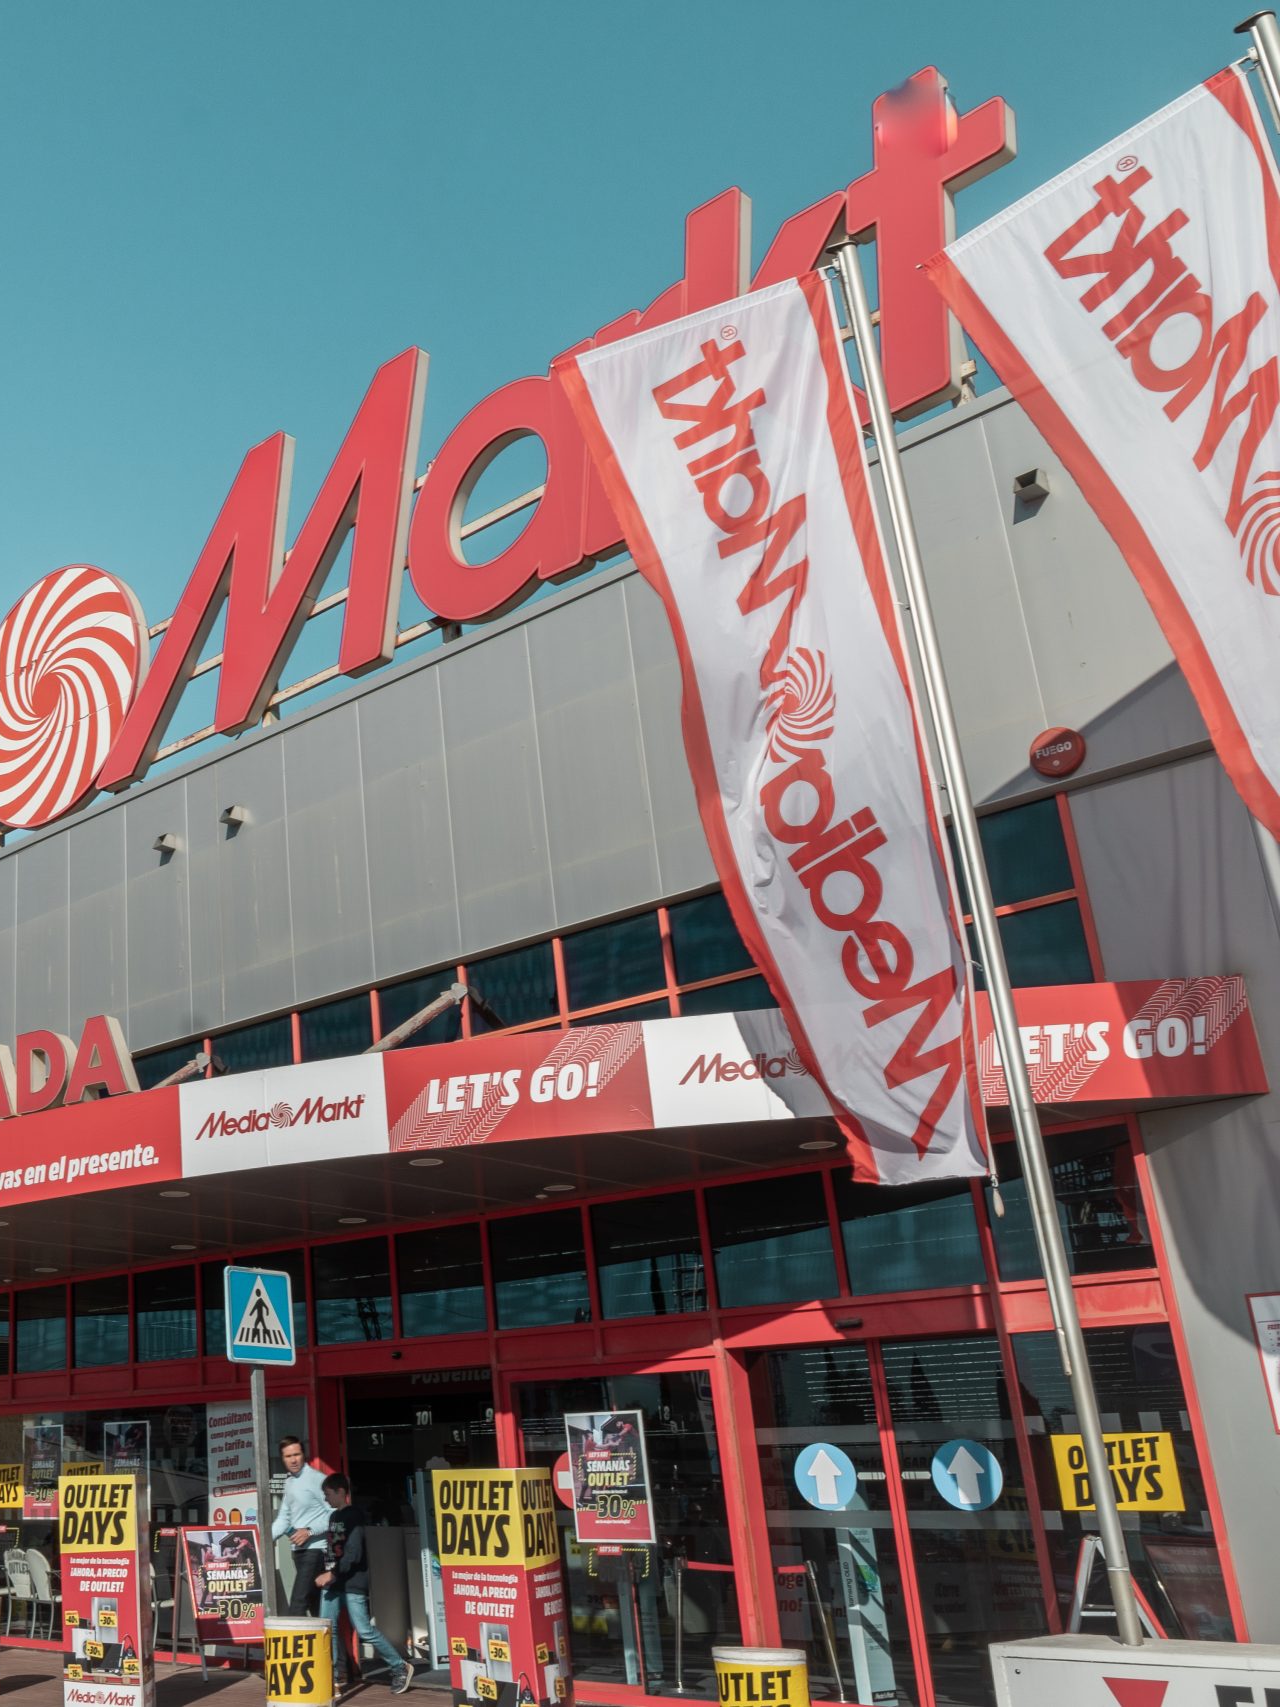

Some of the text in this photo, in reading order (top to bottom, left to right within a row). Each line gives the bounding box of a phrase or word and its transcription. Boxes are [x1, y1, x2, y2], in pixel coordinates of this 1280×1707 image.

[1035, 740, 1073, 760] FUEGO
[1122, 1015, 1209, 1059] GO!
[679, 1053, 788, 1086] Media
[427, 1060, 599, 1114] LET'S GO!
[195, 1094, 364, 1141] Media Markt
[24, 1164, 47, 1186] en
[48, 1157, 66, 1182] el
[68, 1143, 159, 1178] presente.
[209, 1412, 252, 1428] Consúltano
[225, 1440, 245, 1451] tarifa
[1068, 1436, 1159, 1470] OTLET
[218, 1455, 239, 1468] móvil
[587, 1460, 630, 1473] SEMANAS
[221, 1468, 251, 1481] internet
[588, 1473, 629, 1487] OUTLET
[63, 1484, 132, 1508] OUTLET
[440, 1480, 513, 1511] OUTLET
[520, 1479, 552, 1511] OUTLET
[588, 1494, 636, 1518] -30%
[61, 1511, 127, 1545] DAYS
[441, 1513, 510, 1558] DAYS
[523, 1511, 556, 1558] DAYS
[70, 1568, 96, 1578] ¡AHORA,
[103, 1568, 128, 1578] PRECIO
[207, 1570, 248, 1580] SEMANAS
[457, 1572, 473, 1581] mejor
[487, 1573, 518, 1584] tecnología
[79, 1581, 124, 1592] DE OUTLET!
[208, 1581, 247, 1593] OUTLET
[453, 1584, 517, 1599] ¡AHORA, A PRECIO
[210, 1599, 256, 1620] -30%
[465, 1601, 514, 1618] DE OUTLET!
[265, 1634, 316, 1660] UTLET
[267, 1660, 314, 1696] AYS
[719, 1670, 791, 1702] UTLET
[67, 1688, 135, 1706] Media Markt
